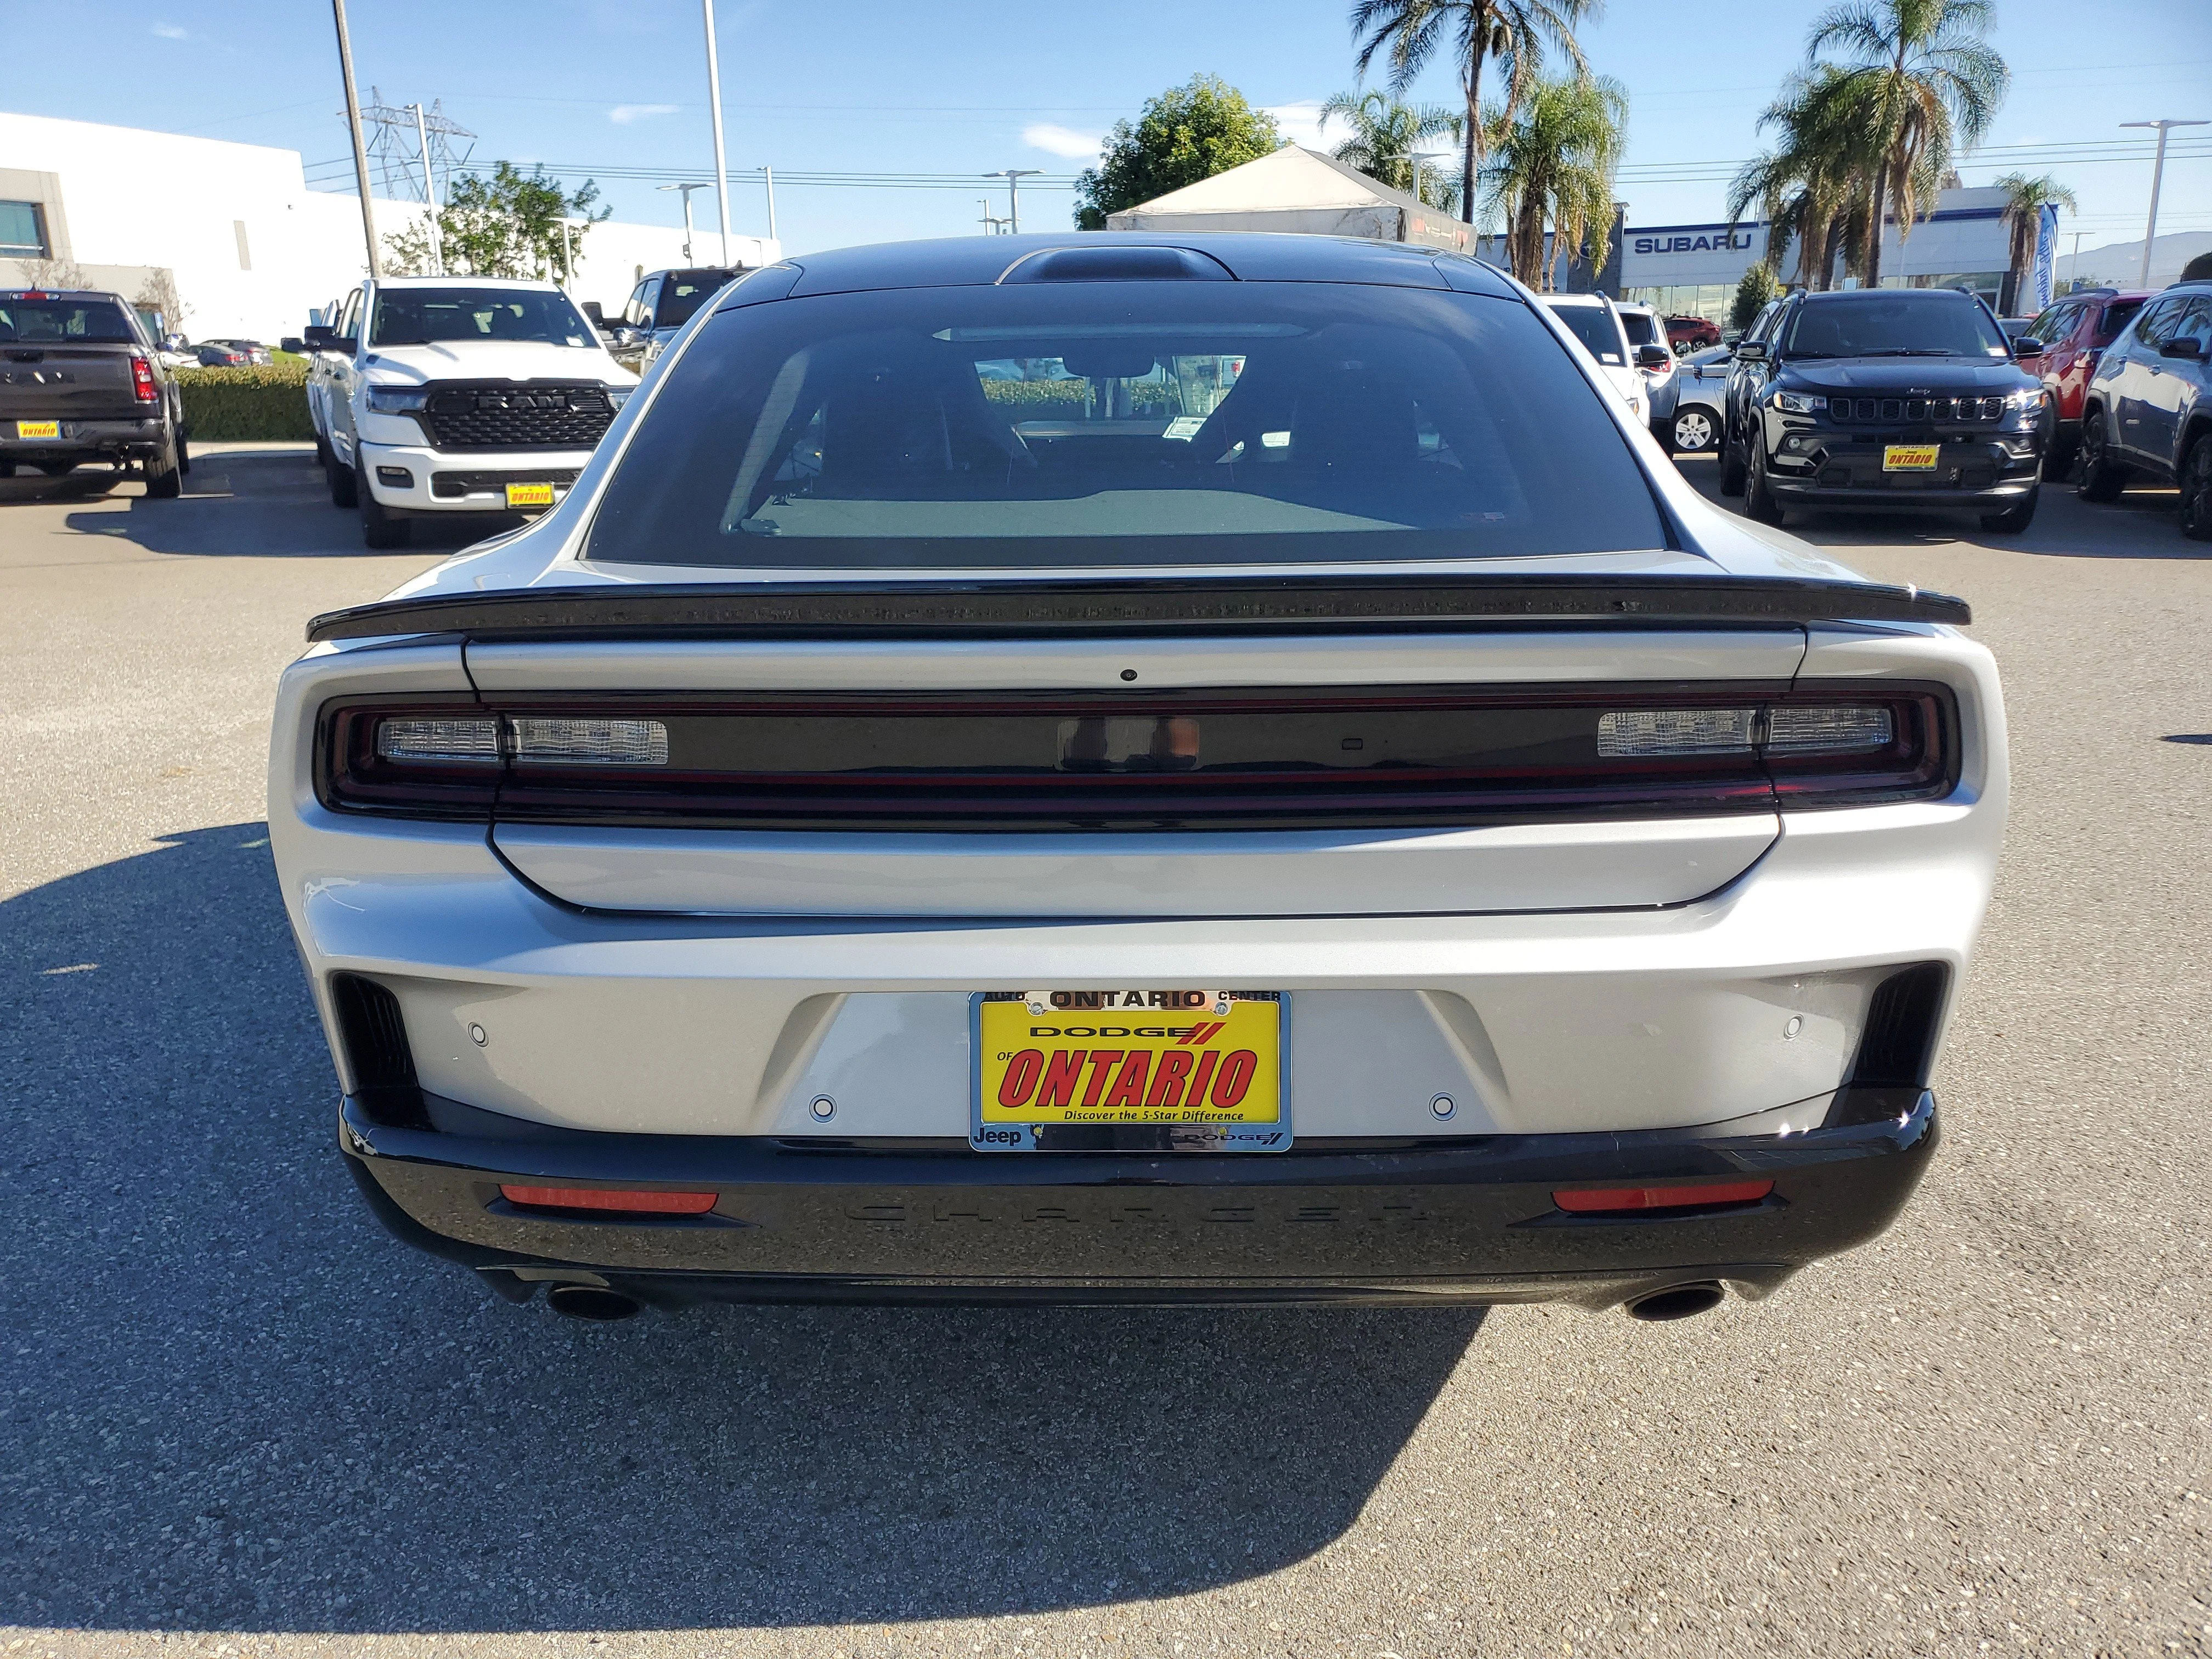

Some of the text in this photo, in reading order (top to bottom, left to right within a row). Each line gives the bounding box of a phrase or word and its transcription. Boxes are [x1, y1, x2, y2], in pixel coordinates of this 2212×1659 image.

[1635, 234, 1751, 253] SUBARU
[479, 396, 565, 408] RAM
[1889, 455, 1932, 464] ONTARIO
[512, 493, 549, 502] ONTARIO
[1050, 991, 1205, 1007] ONTARIO
[1218, 991, 1281, 1001] CENTER
[1030, 1027, 1197, 1037] DODGE
[997, 1048, 1258, 1109] OF ONTARIO
[1064, 1110, 1244, 1122] Discover the 5-Star Difference
[973, 1127, 1022, 1147] Jeep
